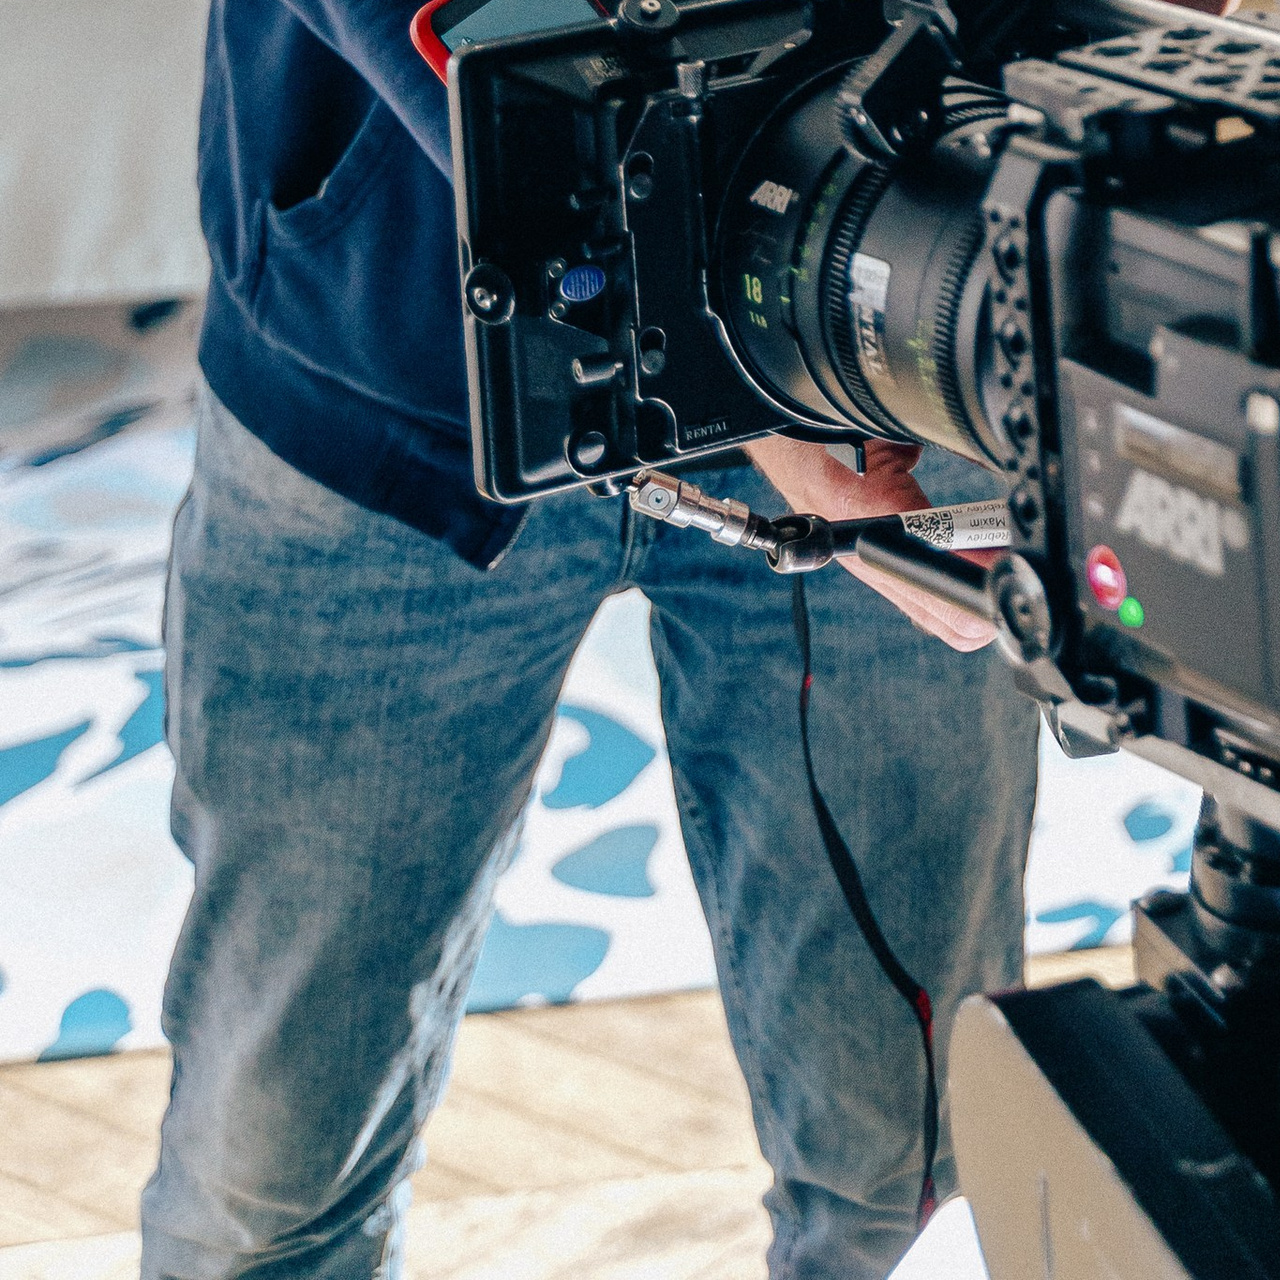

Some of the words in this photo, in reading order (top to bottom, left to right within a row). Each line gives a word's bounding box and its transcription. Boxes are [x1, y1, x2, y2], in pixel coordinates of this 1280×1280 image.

[744, 273, 763, 304] 18
[970, 517, 1006, 528] Maxim
[967, 531, 1009, 542] Rebriev
